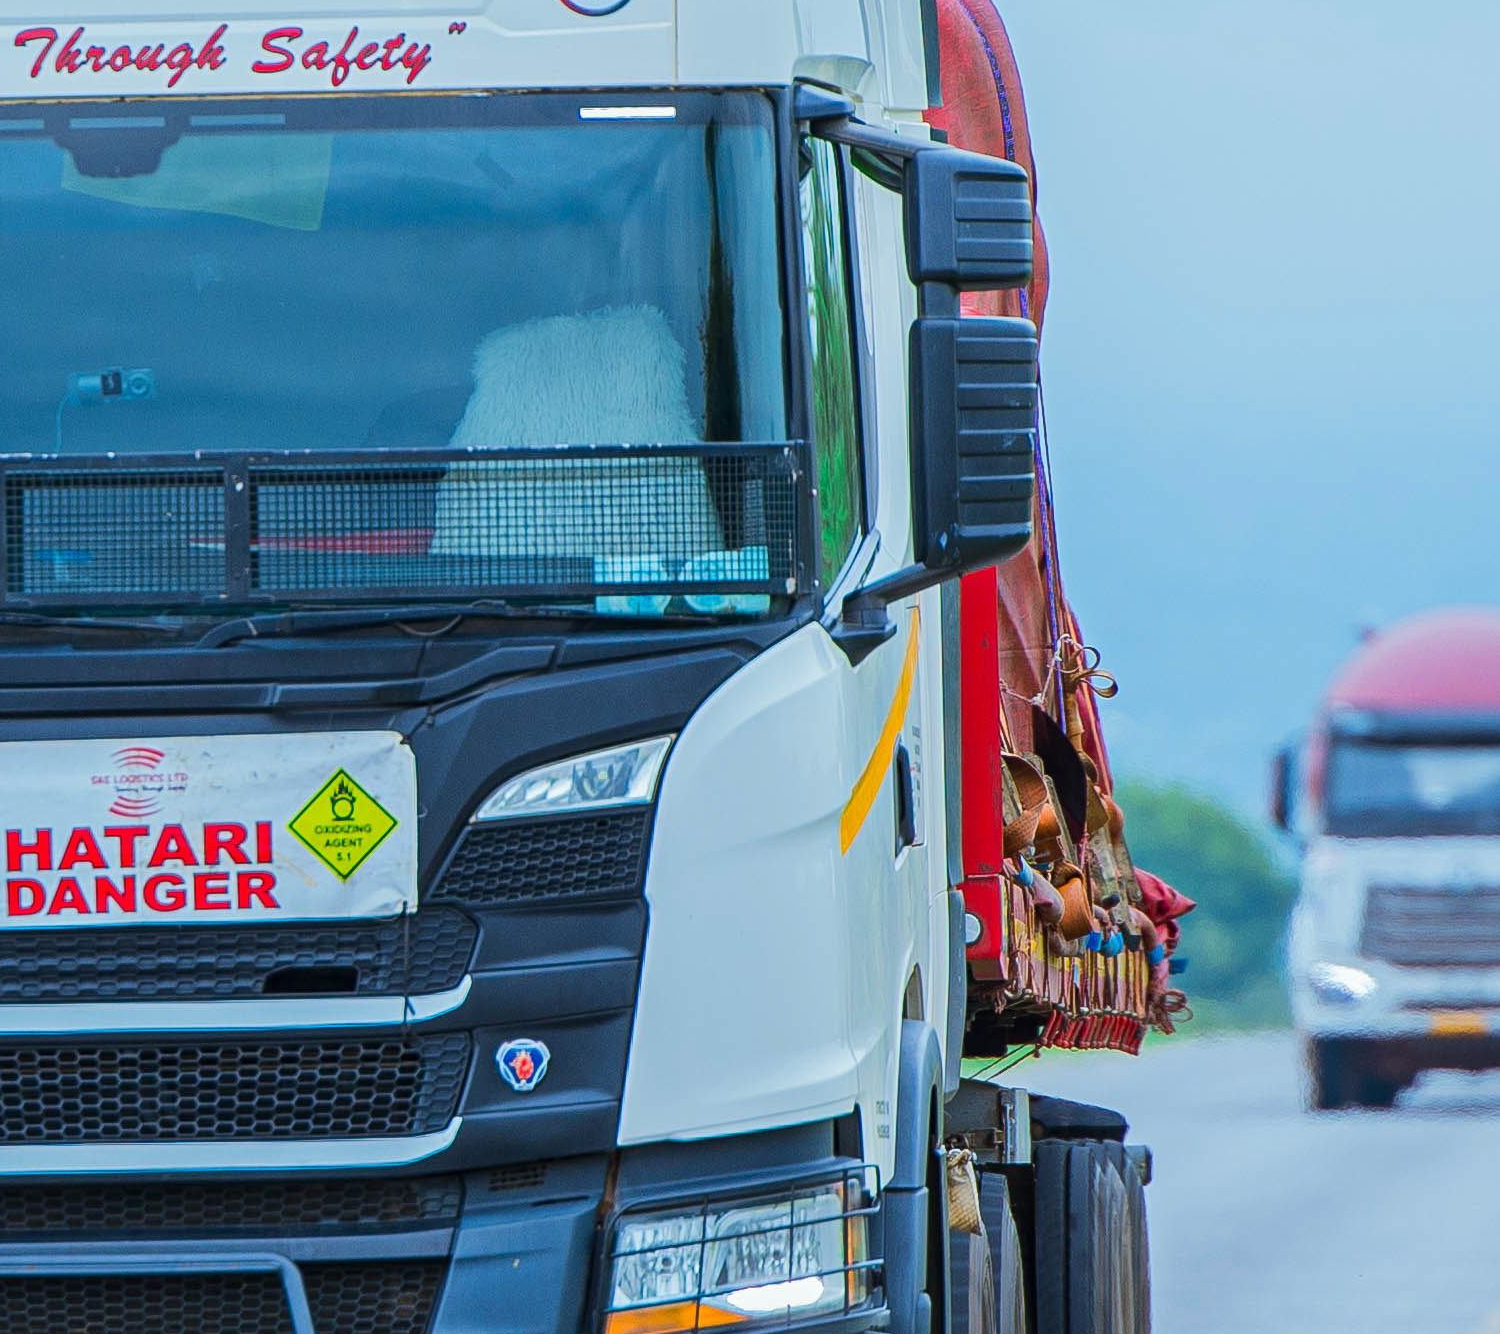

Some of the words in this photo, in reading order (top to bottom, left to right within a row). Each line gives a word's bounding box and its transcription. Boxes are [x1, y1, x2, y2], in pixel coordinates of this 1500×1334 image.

[14, 24, 228, 88] Through
[6, 821, 273, 872] HATARI
[325, 837, 363, 848] AGENT
[6, 870, 281, 917] DANGER
